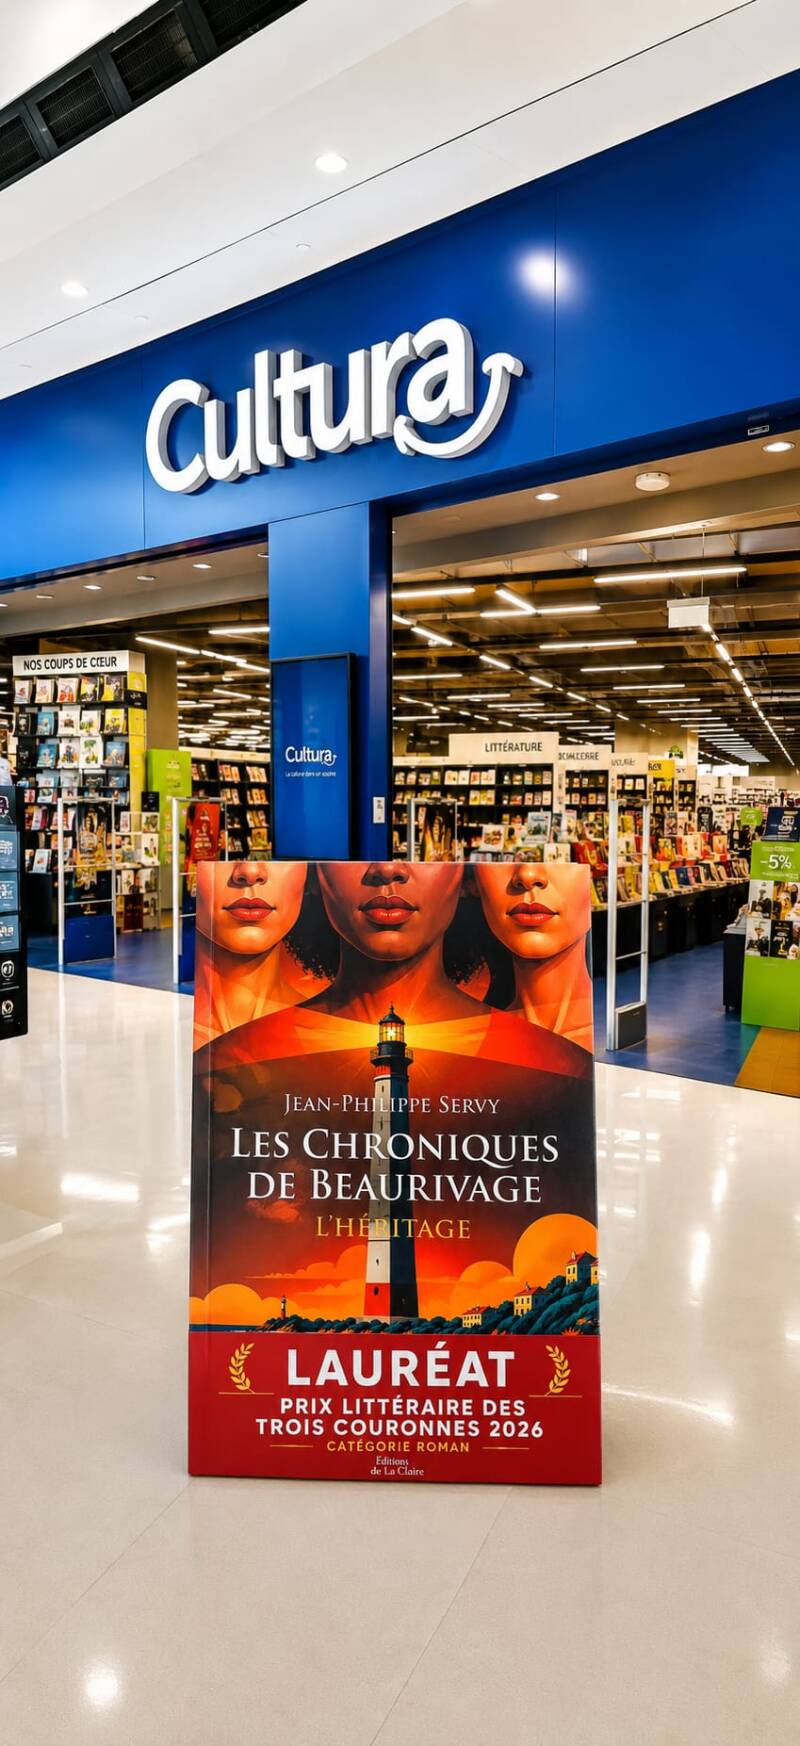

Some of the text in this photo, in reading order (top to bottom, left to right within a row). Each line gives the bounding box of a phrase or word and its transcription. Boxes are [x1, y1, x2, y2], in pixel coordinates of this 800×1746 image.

[146, 317, 524, 494] Cultura
[23, 656, 117, 671] NOS COUPS DE CŒUR
[285, 746, 337, 766] Cultura
[484, 739, 543, 752] LITTÉRATURE
[760, 854, 792, 870] -5%
[283, 1093, 500, 1116] JEAN-PHILIPPE SERVY
[231, 1127, 559, 1169] LES CHRONIQUES
[248, 1168, 542, 1203] DE BEAURIVAGE
[316, 1213, 471, 1240] L’HÉRITAGE
[288, 1341, 515, 1388] LAURÉAT
[281, 1395, 526, 1417] PRIX LITTÉRAIRE DES
[255, 1418, 543, 1438] TROIS COURONNES 2026
[327, 1439, 470, 1453] CATÉGORIE ROMAN
[370, 1467, 425, 1476] de La Claire
